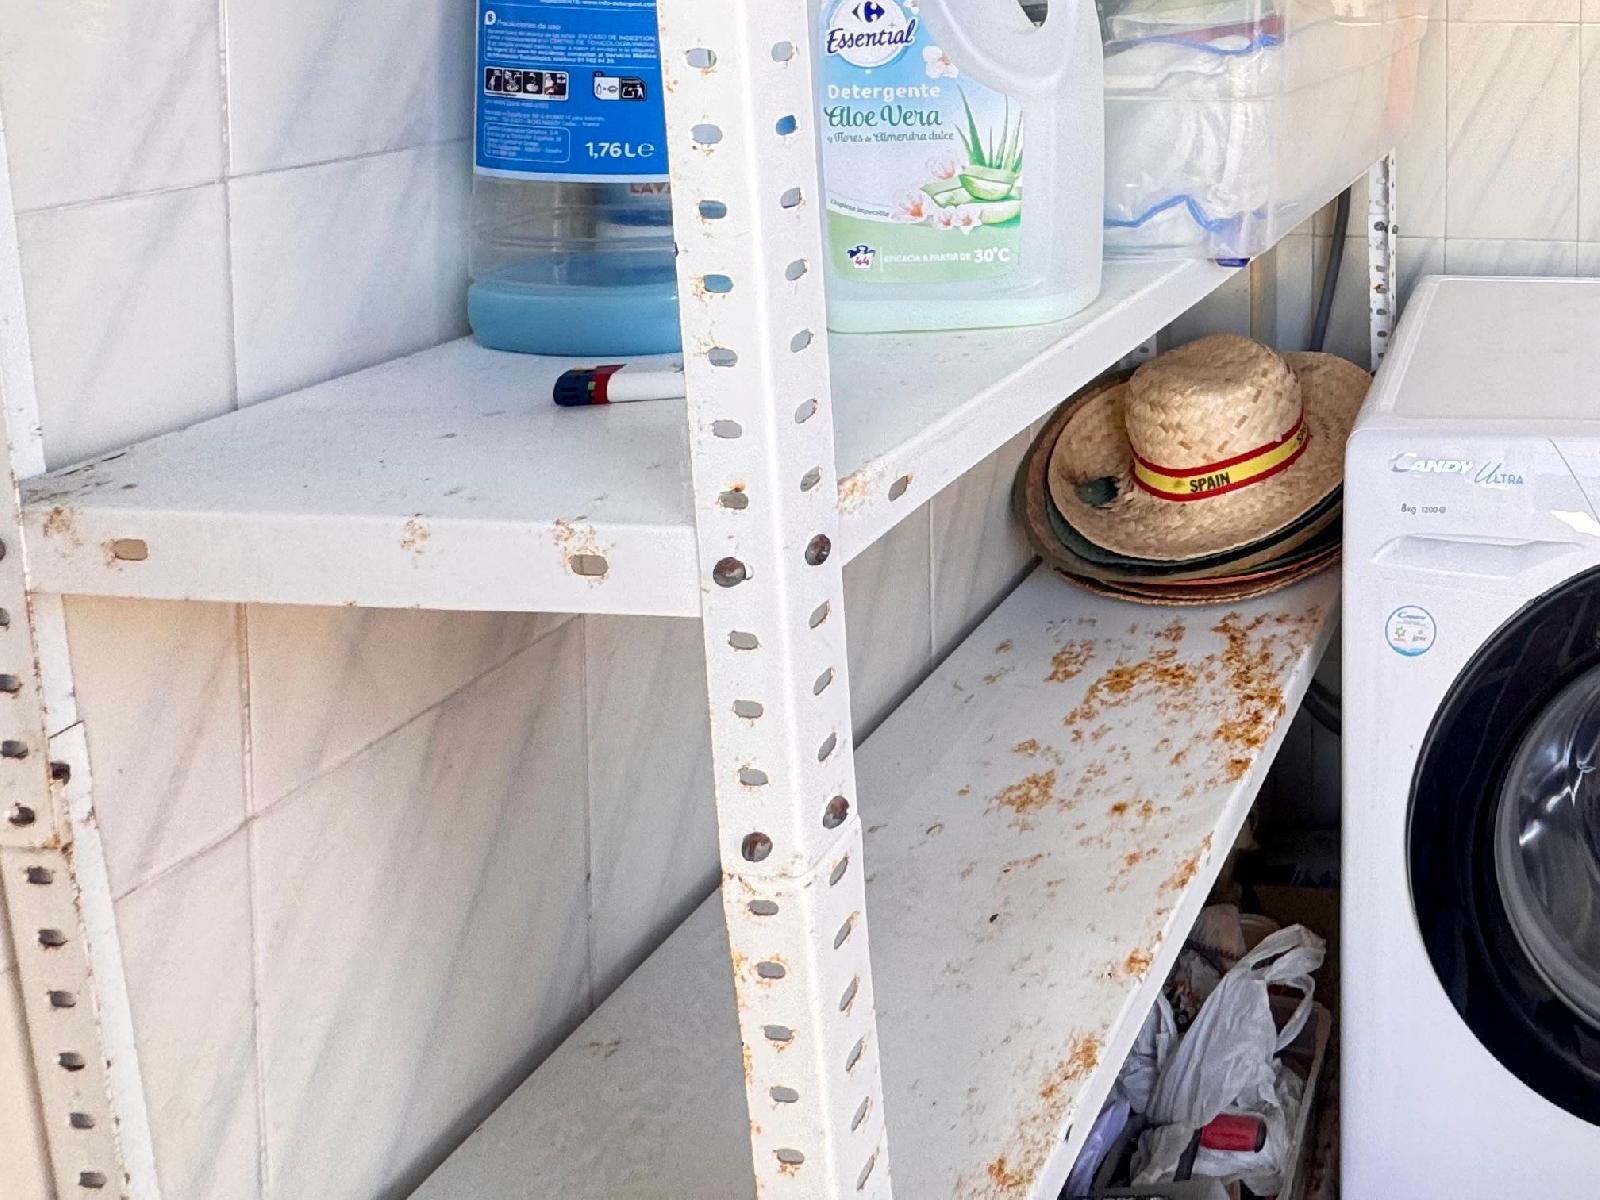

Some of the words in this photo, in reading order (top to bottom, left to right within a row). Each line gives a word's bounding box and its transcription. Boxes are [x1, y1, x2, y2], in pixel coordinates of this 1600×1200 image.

[827, 18, 916, 54] Essential
[828, 84, 941, 101] Detergente
[824, 105, 878, 127] Aloe
[881, 104, 942, 127] Vera
[833, 131, 863, 143] Flores
[872, 131, 927, 143] Almendra
[928, 129, 954, 141] dulce
[585, 142, 621, 159] 1,76
[855, 255, 870, 266] 44
[974, 246, 1011, 263] 30°C
[1189, 472, 1231, 493] SPAIN
